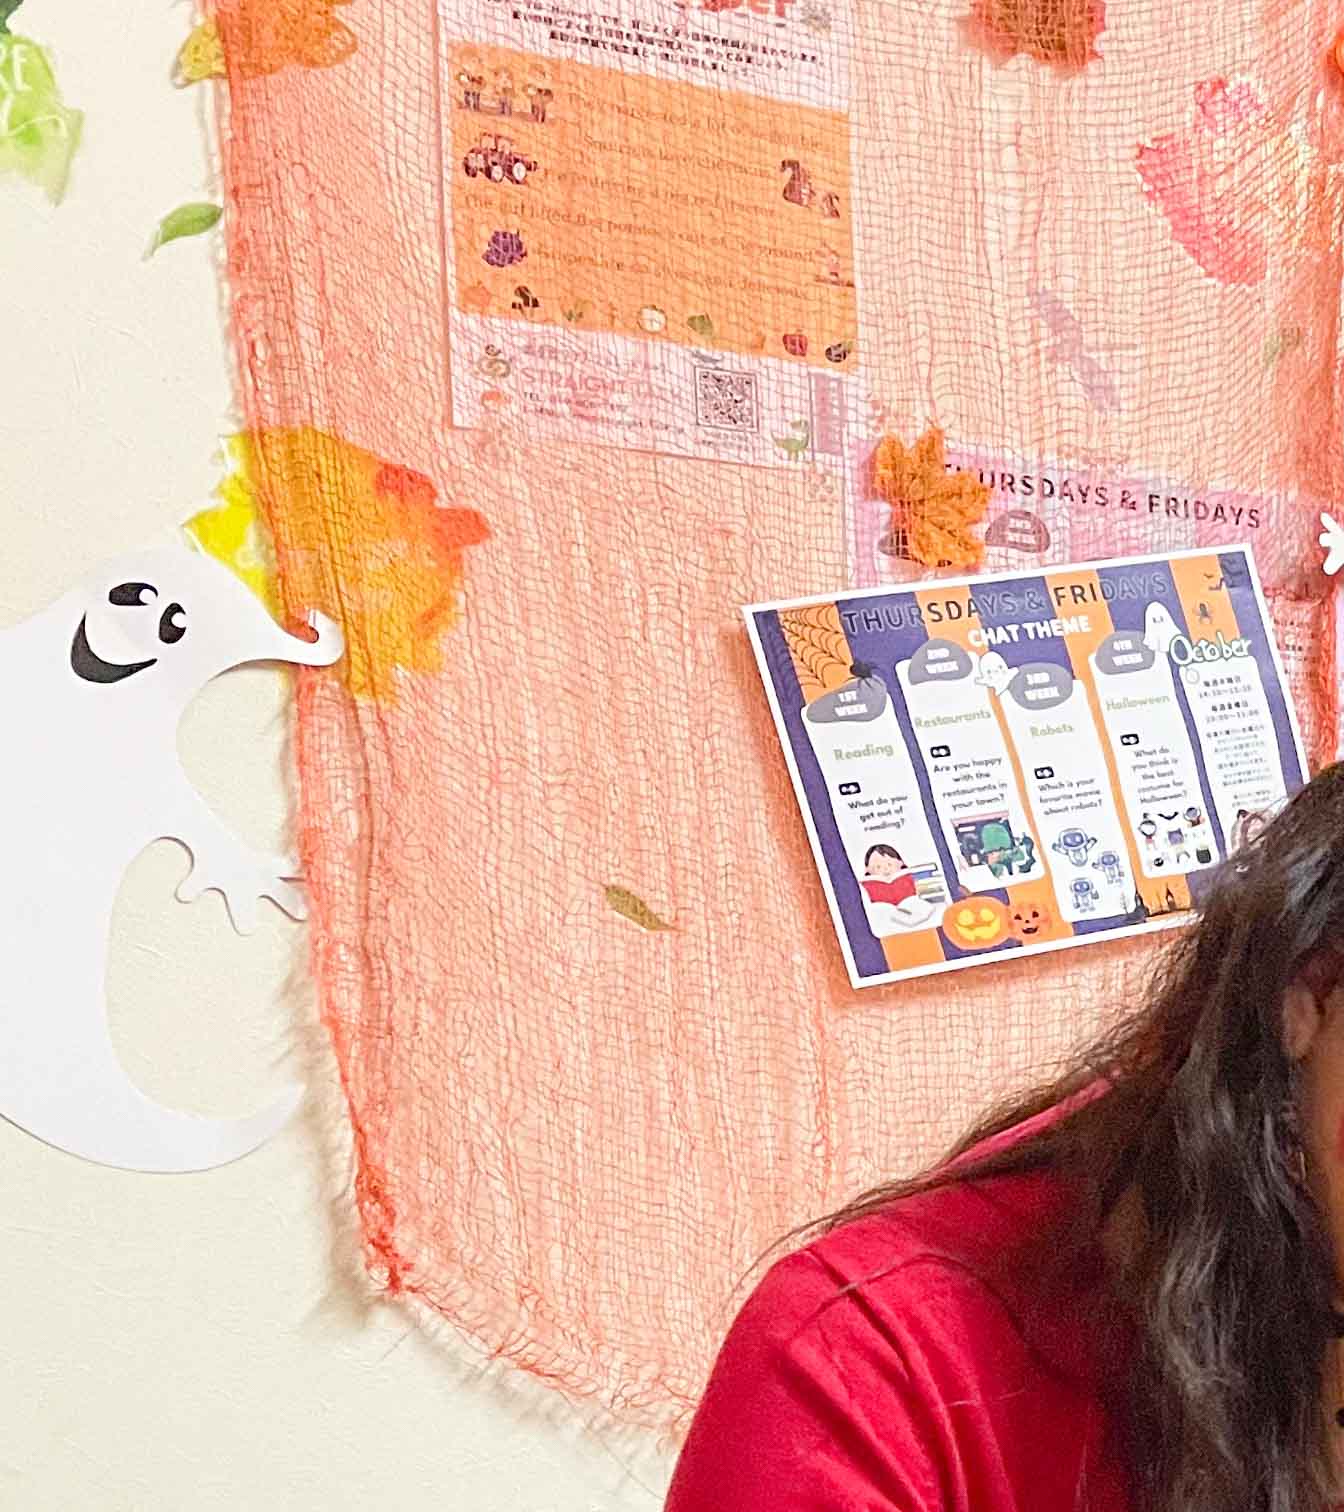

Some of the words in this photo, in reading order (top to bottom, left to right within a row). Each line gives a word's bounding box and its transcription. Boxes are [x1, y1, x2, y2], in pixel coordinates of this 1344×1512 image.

[1147, 492, 1261, 529] FRIDAYS
[842, 591, 1019, 635] THURSDAYS
[1023, 587, 1046, 613] &
[1053, 572, 1170, 607] FRIDAYS
[967, 623, 1019, 648] CHAT
[1021, 615, 1093, 640] THEME
[1169, 631, 1252, 668] October
[1105, 694, 1171, 713] Halloween
[914, 708, 992, 730] Restaurants
[1029, 724, 1075, 739] Robots
[834, 743, 895, 762] Reading
[932, 763, 952, 774] Are
